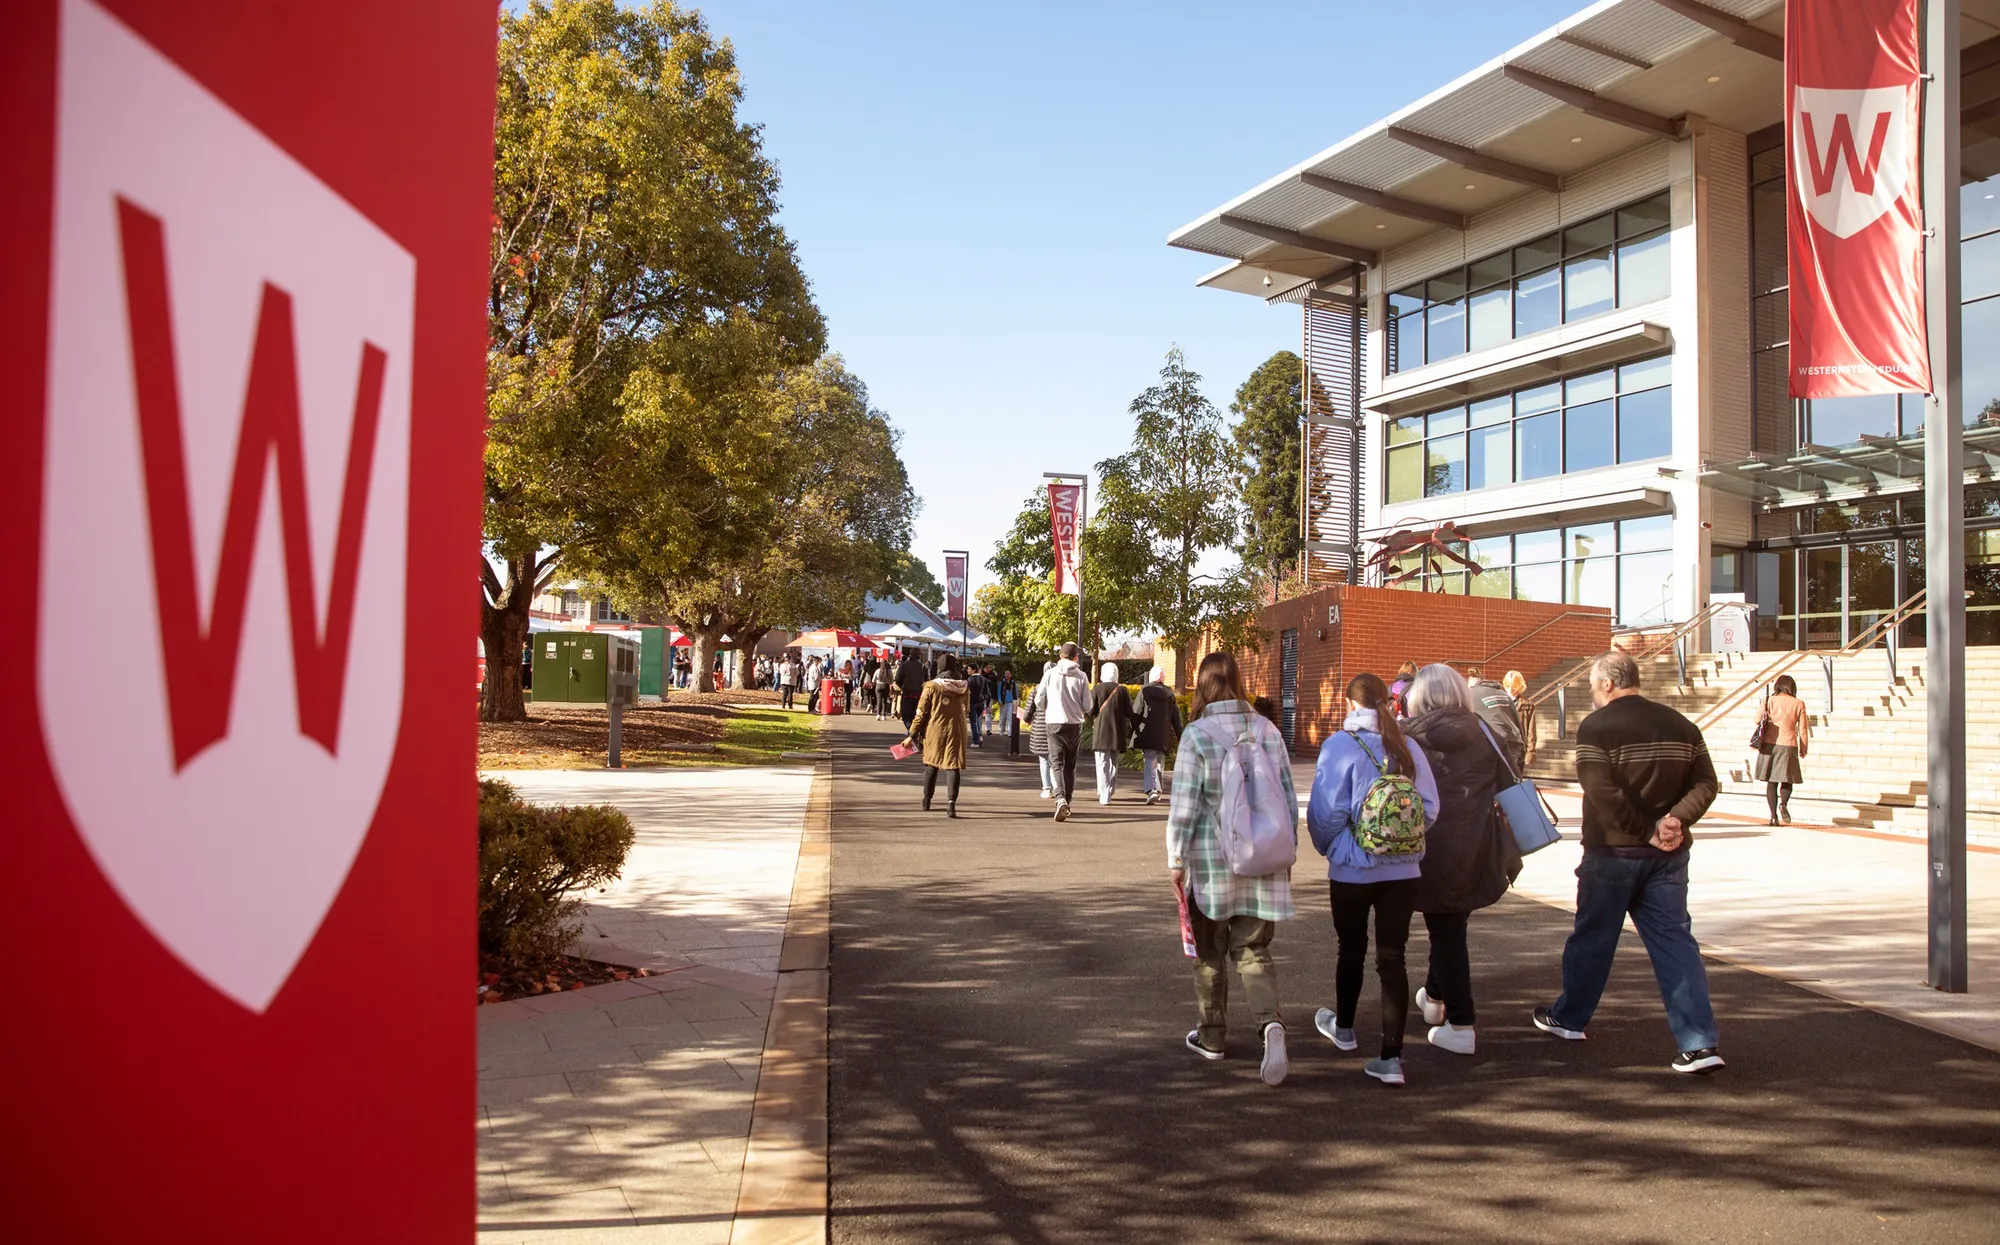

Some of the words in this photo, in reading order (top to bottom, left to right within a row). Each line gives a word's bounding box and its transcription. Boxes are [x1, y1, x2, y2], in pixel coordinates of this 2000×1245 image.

[1801, 111, 1892, 197] W
[113, 192, 388, 776] W
[950, 580, 963, 592] W
[1329, 605, 1340, 624] EA
